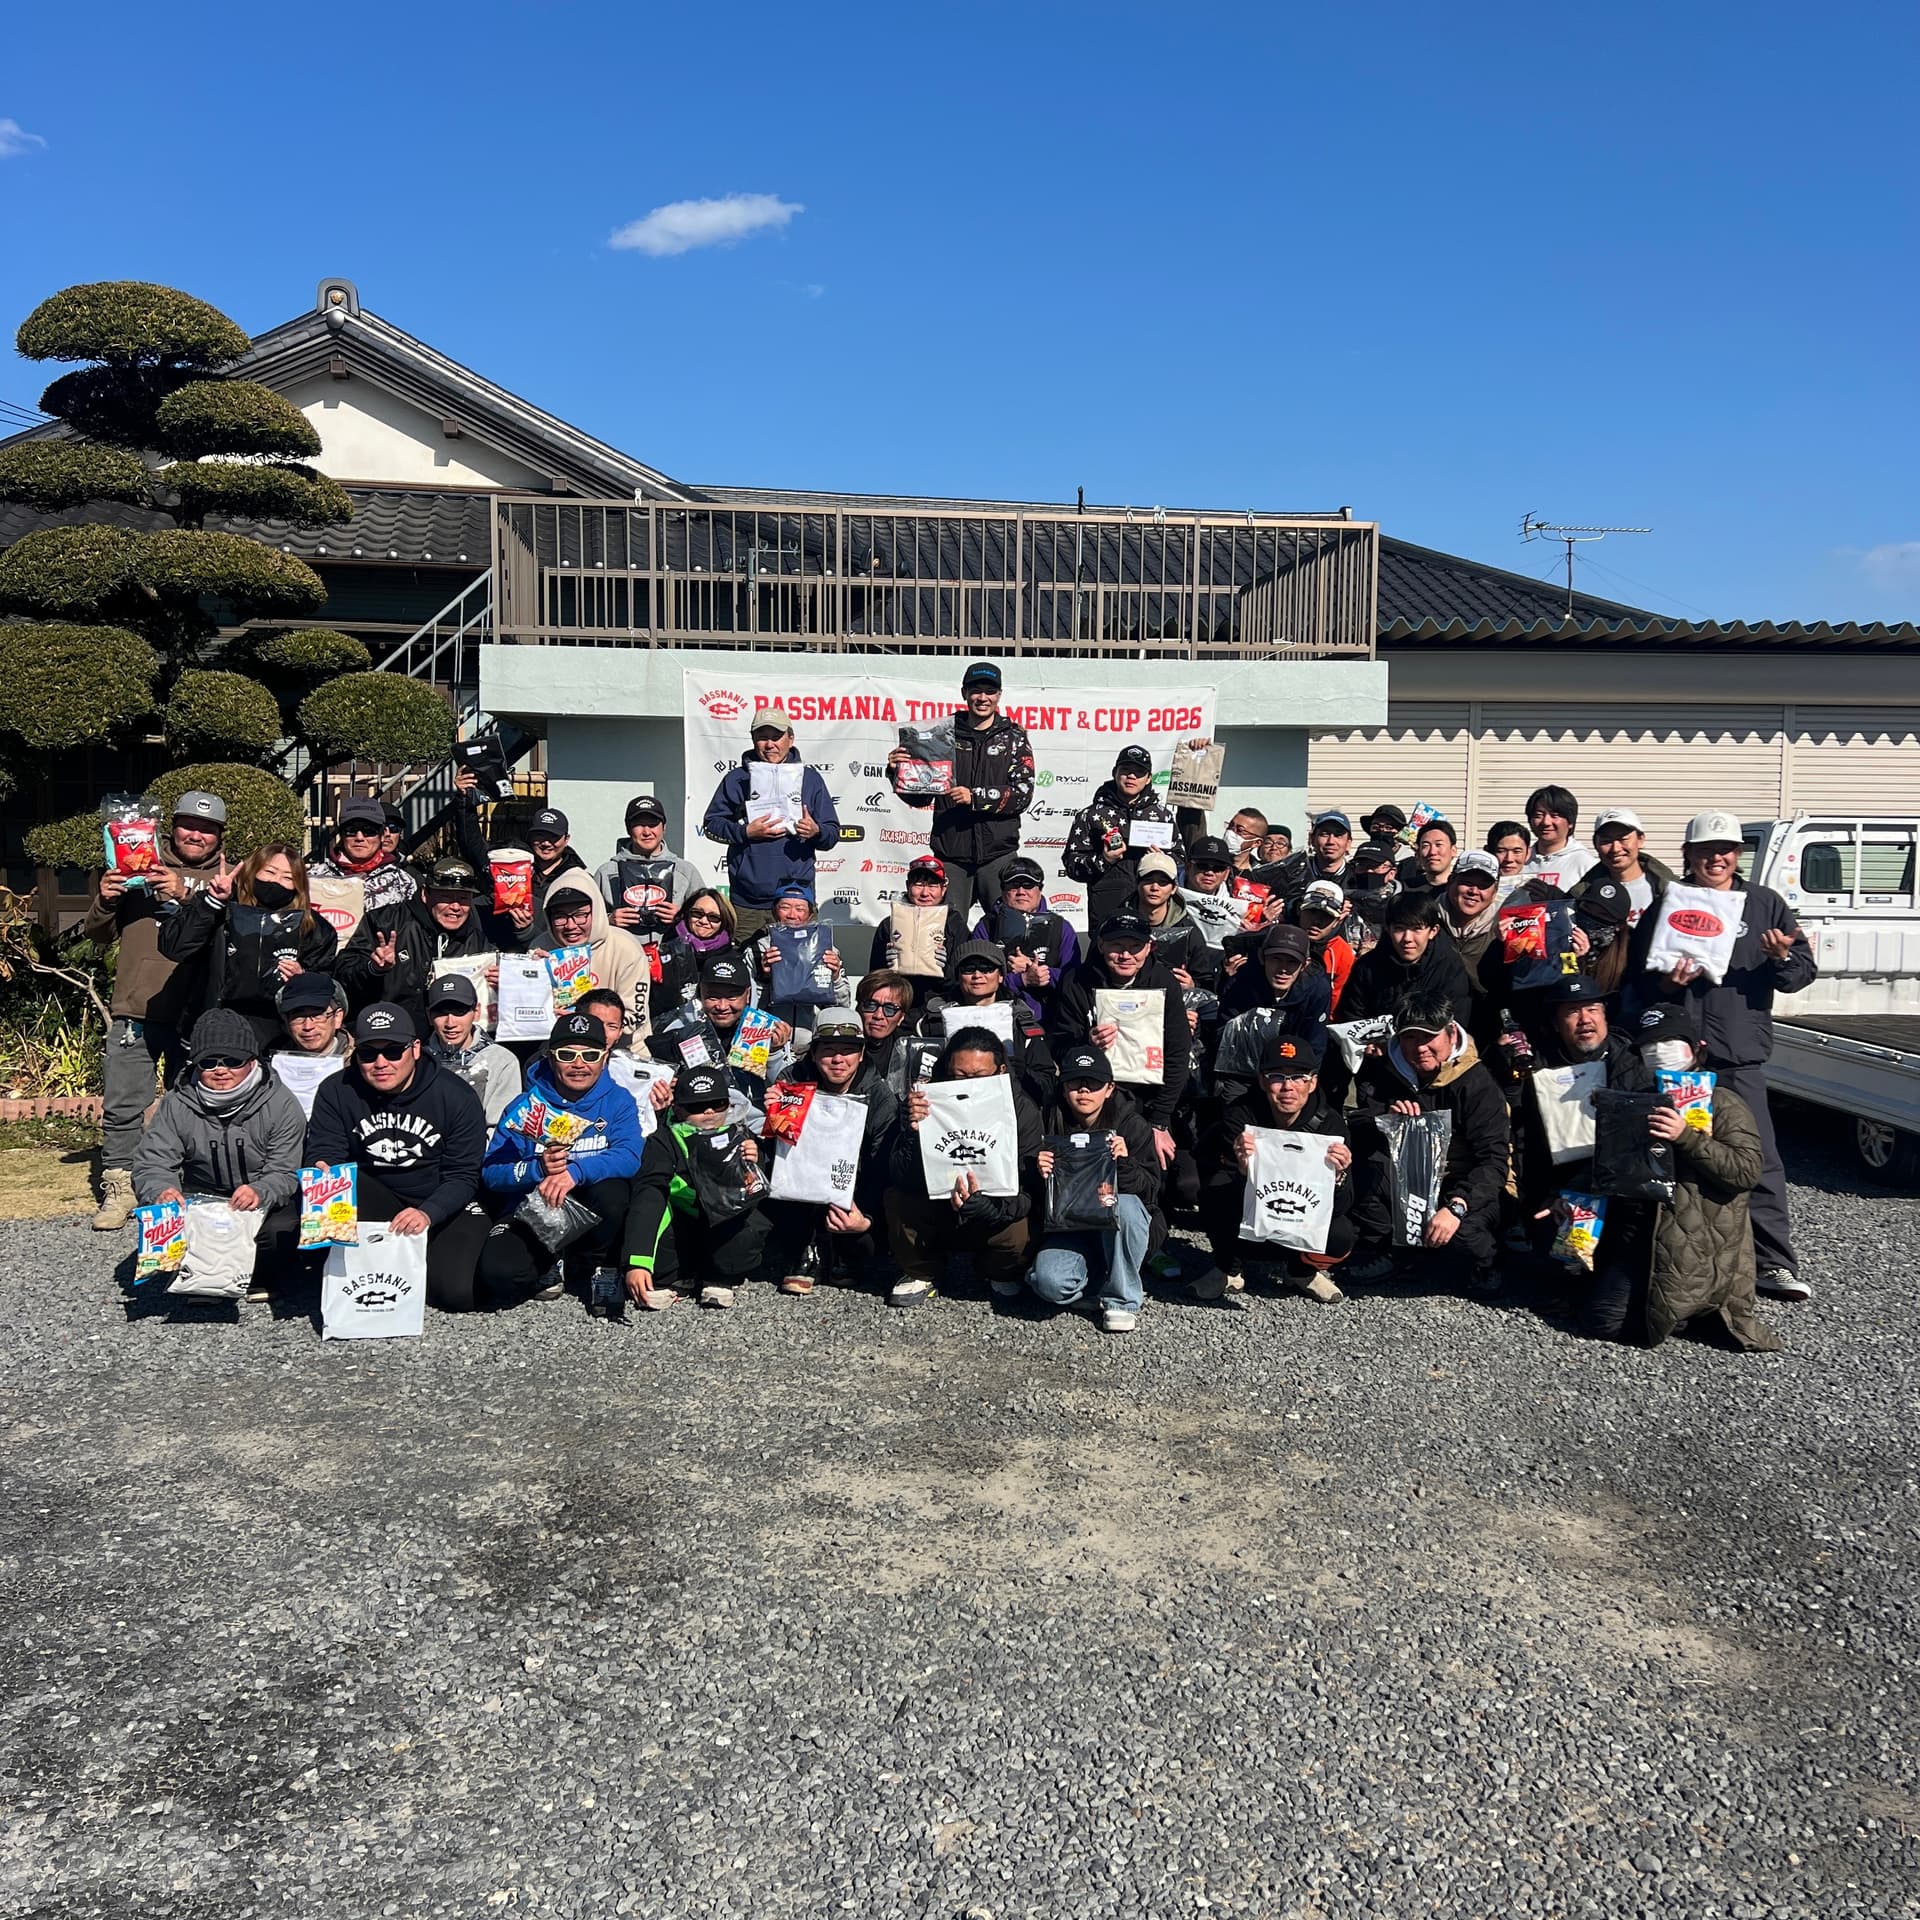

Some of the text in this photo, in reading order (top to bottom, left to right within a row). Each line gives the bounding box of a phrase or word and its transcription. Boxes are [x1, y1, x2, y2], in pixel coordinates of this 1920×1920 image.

[698, 689, 749, 709] BASSMANIA
[905, 700, 1072, 731] TOUMENT
[1077, 710, 1090, 730] &
[1094, 708, 1140, 732] CUP
[1148, 706, 1202, 732] 2026
[864, 765, 883, 778] GAN
[1055, 775, 1089, 783] RYUGI
[1169, 781, 1217, 795] ASSMANIA
[856, 805, 891, 814] Hayabusa
[839, 828, 862, 838] UEL
[880, 829, 906, 844] AKASHI
[833, 896, 862, 905] COLA
[553, 954, 589, 981] Mike
[1347, 1015, 1390, 1038] BASSMA
[352, 1112, 441, 1147] ASSMANIA
[934, 1129, 997, 1153] BASSMANIA
[303, 1177, 352, 1203] Mike
[1255, 1180, 1321, 1209] BASSMANIA
[342, 1273, 412, 1296] BASSMANIA
